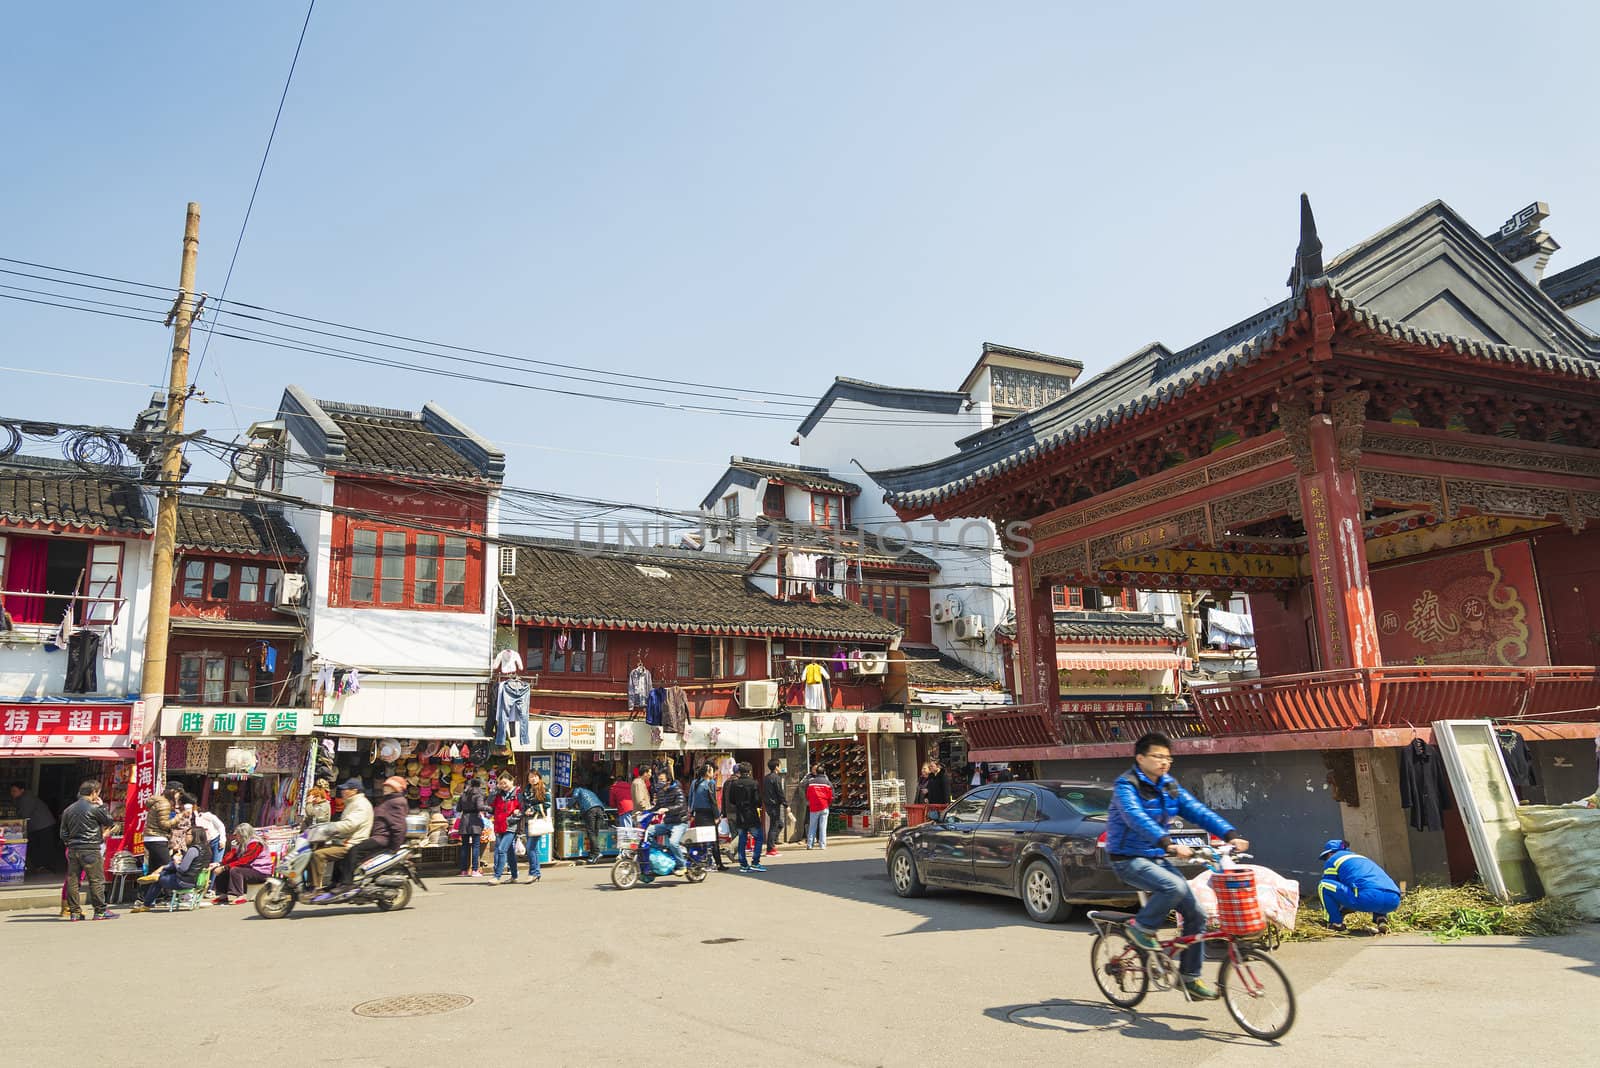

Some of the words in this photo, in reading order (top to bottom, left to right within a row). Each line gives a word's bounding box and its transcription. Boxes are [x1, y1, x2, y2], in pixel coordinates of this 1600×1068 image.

[4, 709, 123, 731] 特产超市
[181, 712, 298, 732] 胜利百货
[136, 747, 153, 831] 上海特产
